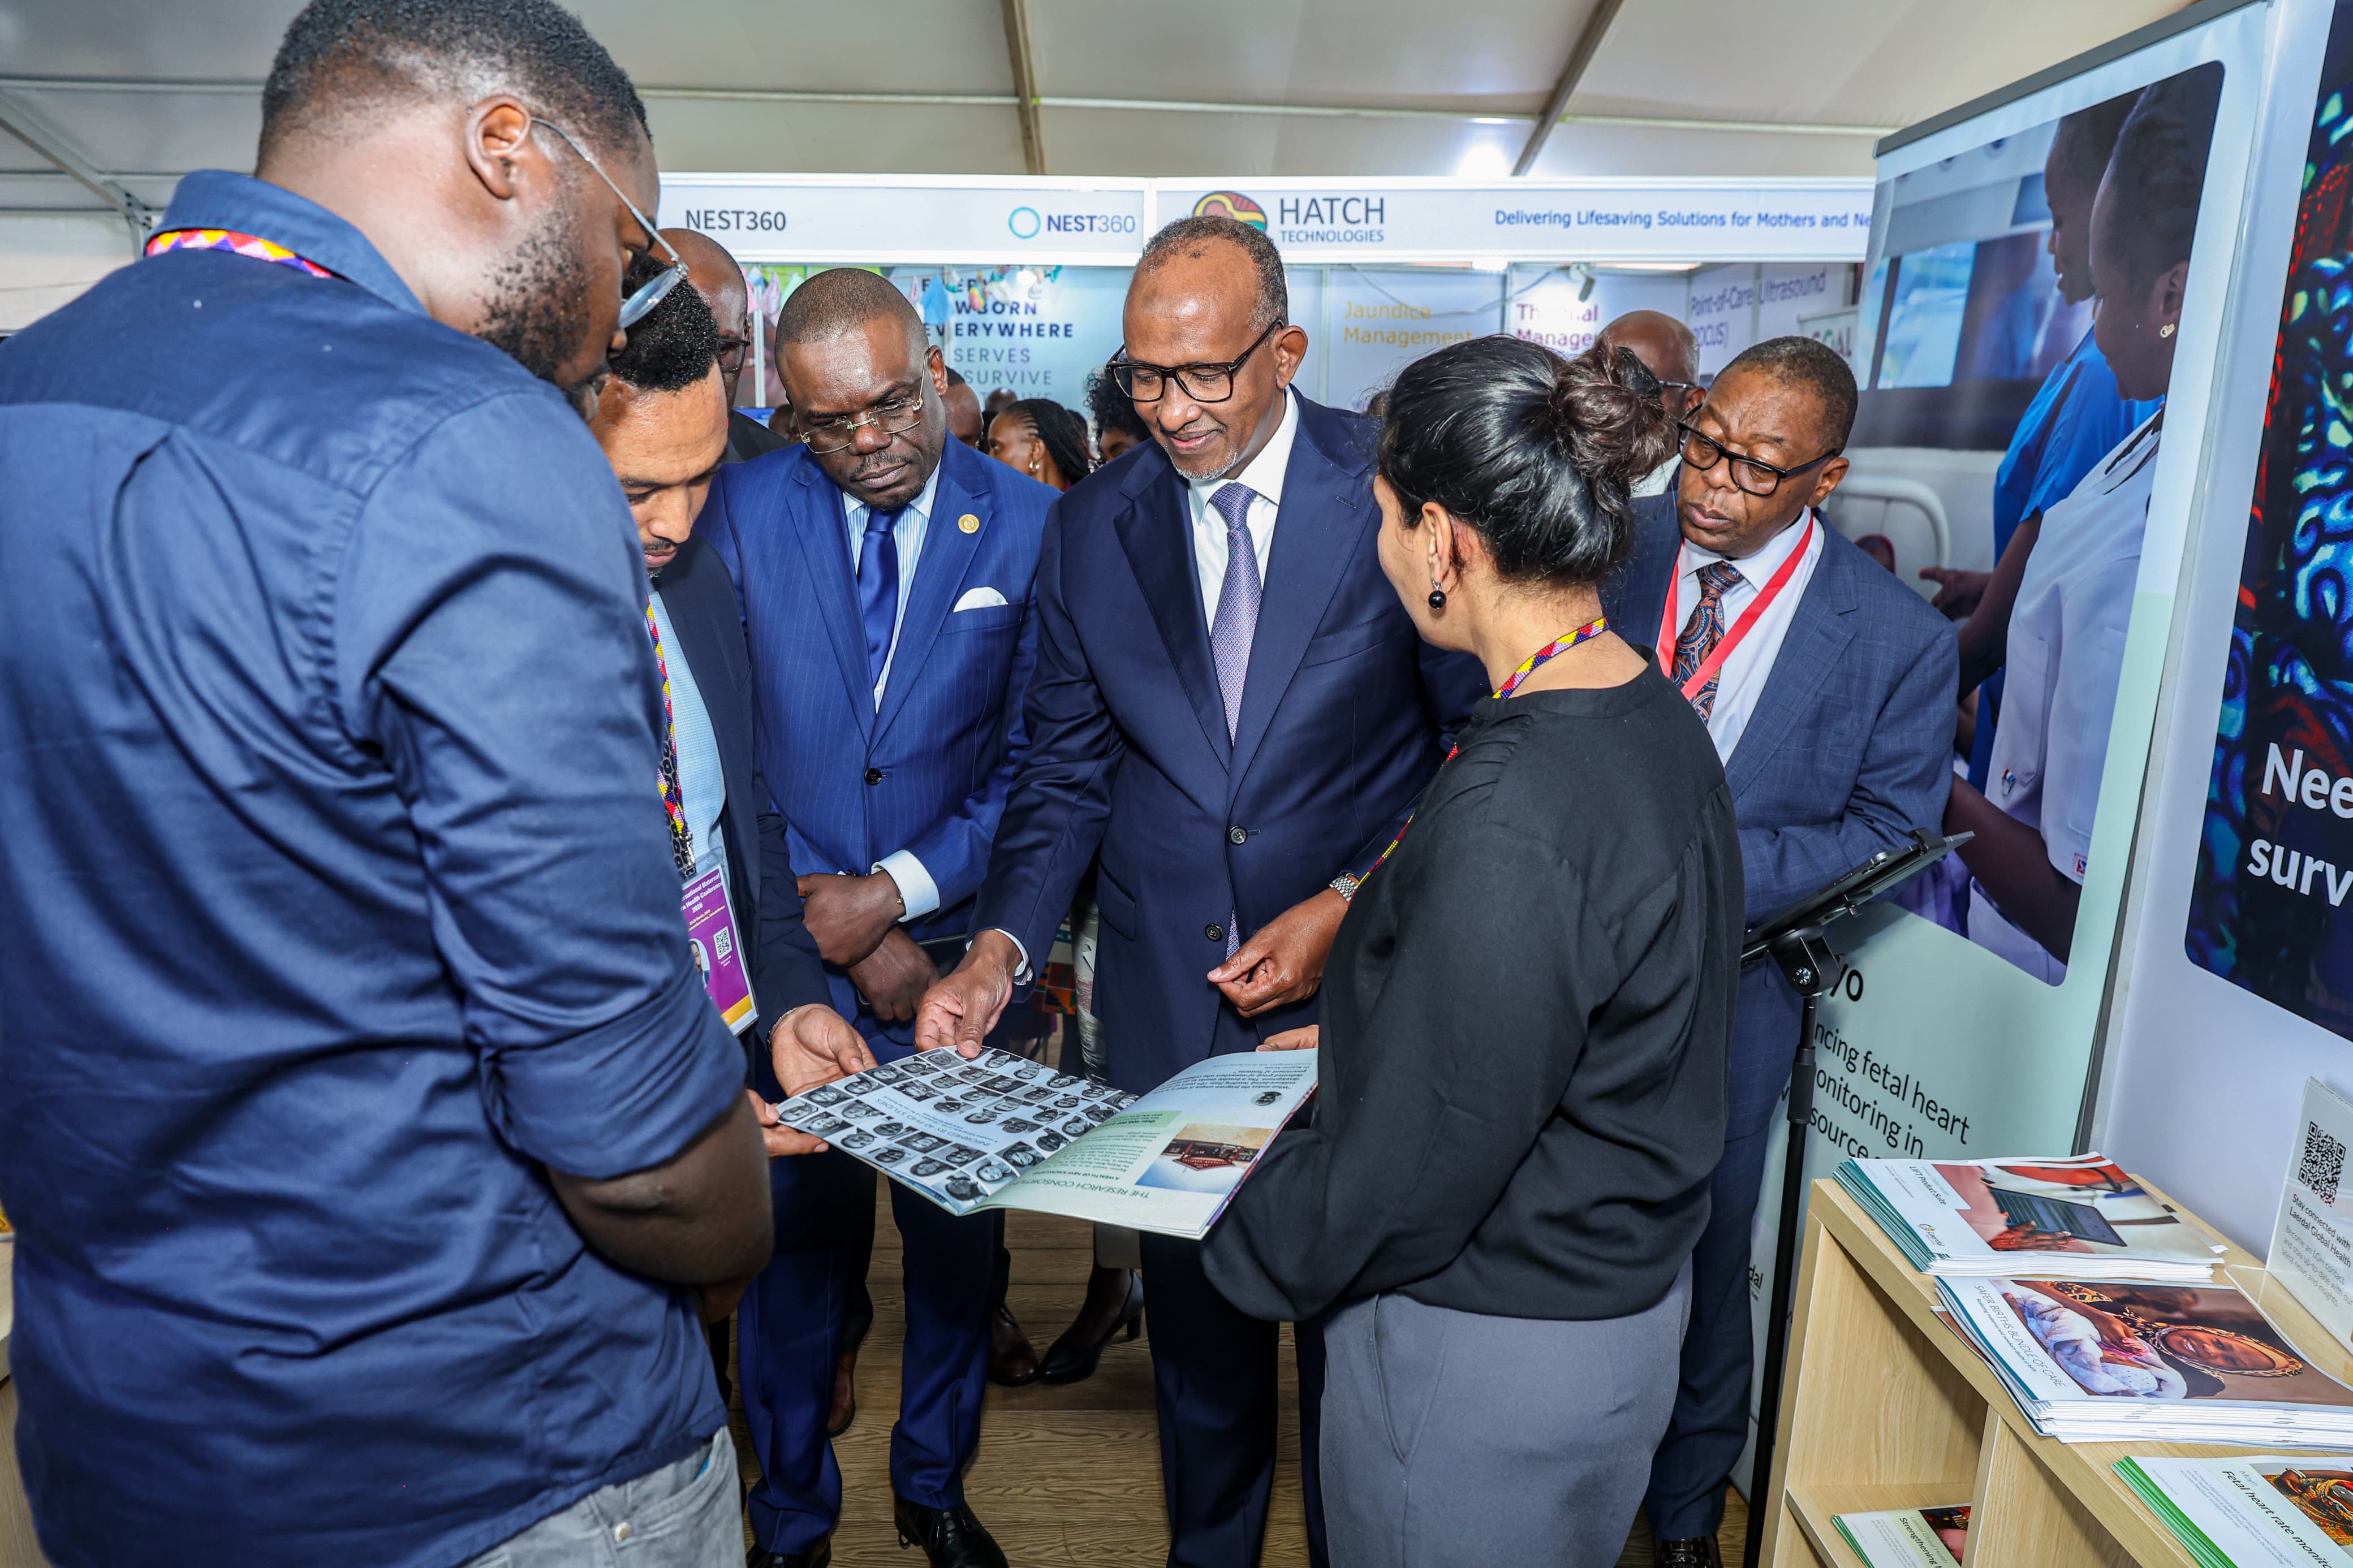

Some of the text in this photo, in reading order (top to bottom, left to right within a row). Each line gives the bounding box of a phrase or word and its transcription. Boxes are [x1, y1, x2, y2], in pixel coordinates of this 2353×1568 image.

[686, 210, 786, 231] NEST360
[1281, 197, 1384, 224] HATCH
[1495, 210, 1571, 228] Delivering
[1577, 210, 1652, 229] Lifesaving
[1657, 211, 1726, 226] Solutions
[1731, 211, 1752, 227] for
[1757, 212, 1816, 227] Mothers
[1821, 213, 1848, 227] and
[1048, 215, 1136, 233] NEST360
[1280, 230, 1385, 243] TECHNOLOGIES
[1691, 267, 1826, 316] Point-of-Care Ultrasound
[955, 300, 1037, 315] WBORN
[1344, 301, 1432, 319] Jaundice
[923, 323, 1074, 337] EVERYWHERE
[954, 348, 1031, 363] SERVES
[963, 370, 1053, 386] SURVIVE
[702, 872, 720, 888] Maternal
[686, 896, 701, 908] Health
[1863, 1051, 1910, 1102] fetal
[1912, 1081, 1970, 1145] heart
[1816, 1069, 1924, 1159] onitoring in
[947, 1131, 991, 1146] INFORMED
[1075, 1182, 1128, 1195] RESEARCH
[1129, 1190, 1149, 1198] THE
[1909, 1167, 1947, 1204] LIFT Product Suite
[2292, 1194, 2351, 1251] Stay connected with
[2290, 1206, 2352, 1269] Laerdal Global Health
[2285, 1225, 2345, 1285] Become an LGH contact
[2281, 1246, 2295, 1265] latest
[2294, 1261, 2308, 1277] news
[2307, 1274, 2318, 1288] and
[2283, 1237, 2293, 1250] and
[2292, 1246, 2304, 1260] stay
[2303, 1257, 2331, 1286] up-to-date
[2330, 1281, 2344, 1297] with
[1974, 1285, 2066, 1387] SAFER BIRTHS BUNDLE OF CARE
[2238, 1470, 2259, 1487] Moyo
[2222, 1471, 2251, 1490] Fetal
[2245, 1492, 2276, 1515] heart
[2270, 1516, 2295, 1535] rate
[1899, 1517, 1937, 1565] Strengthening
